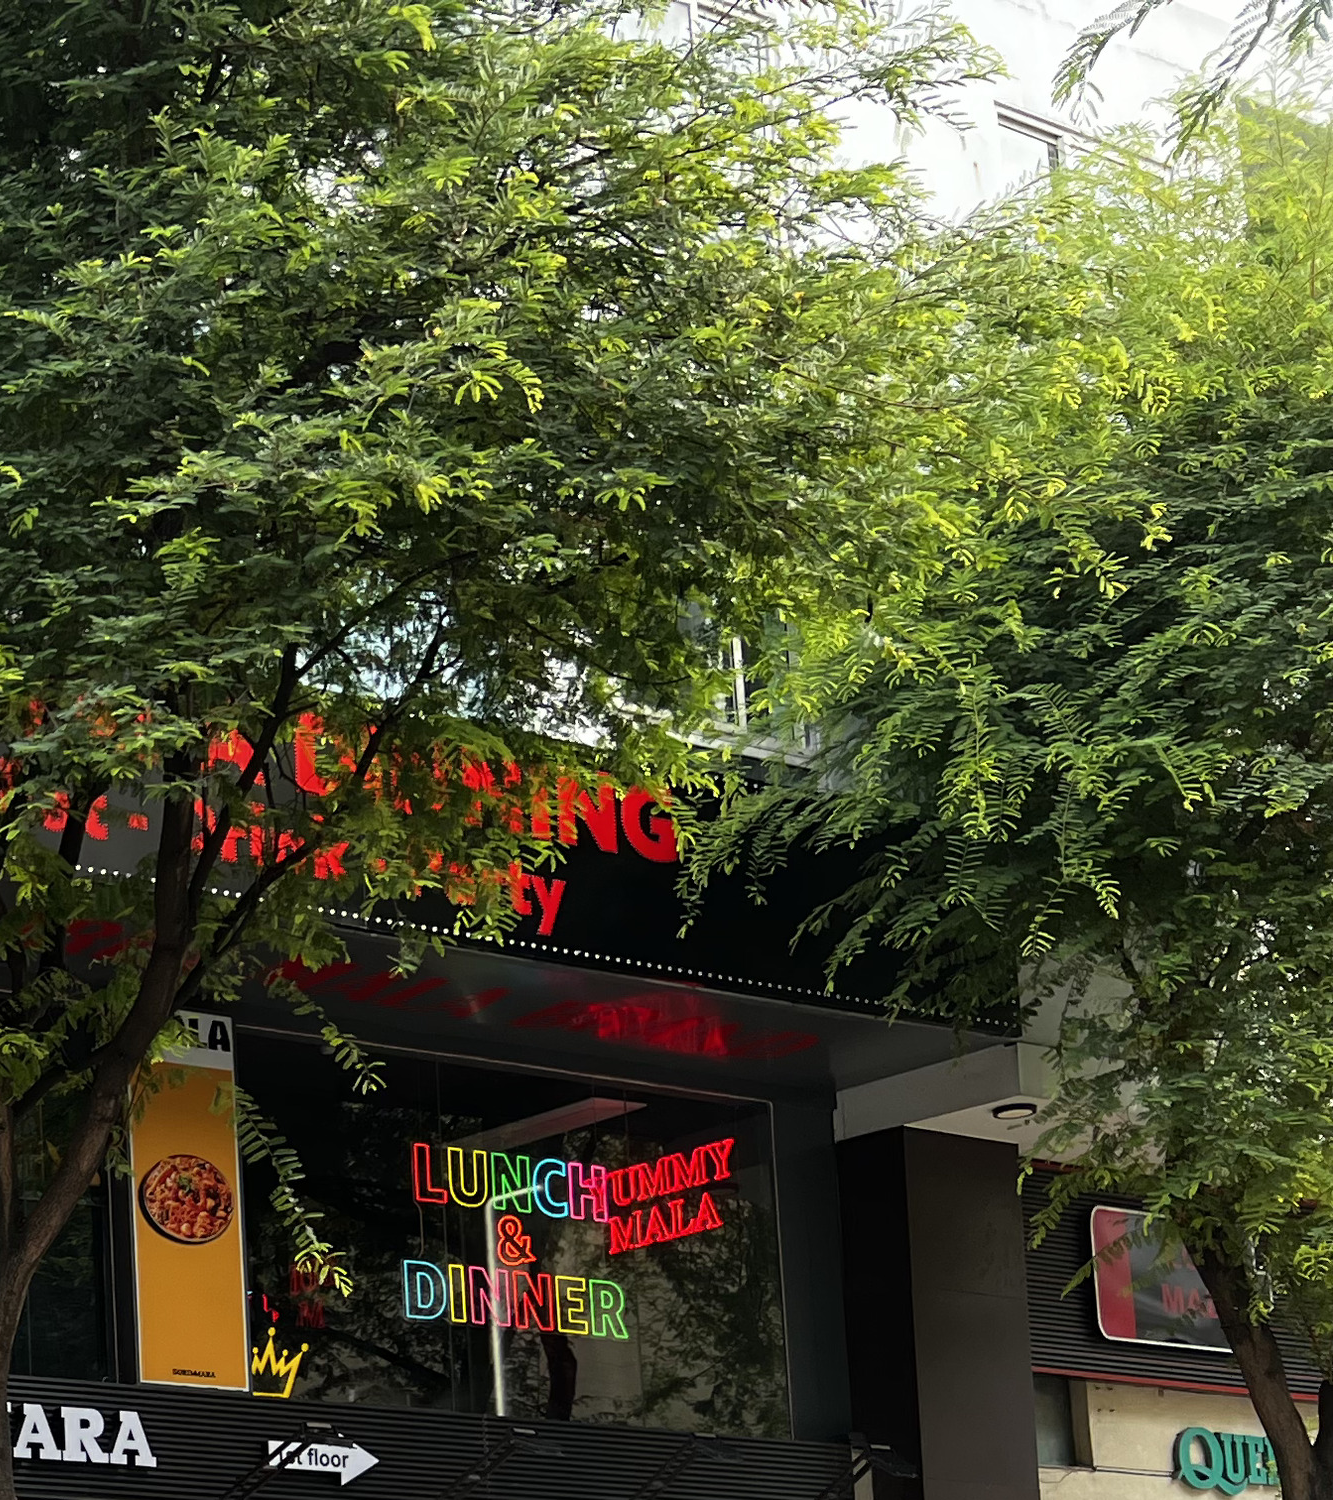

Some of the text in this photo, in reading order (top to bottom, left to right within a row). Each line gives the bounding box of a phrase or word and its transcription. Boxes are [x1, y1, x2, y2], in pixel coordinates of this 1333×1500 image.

[412, 1143, 608, 1223] LUNCH
[498, 1215, 537, 1267] &
[608, 1192, 724, 1255] MALA
[402, 1259, 629, 1340] DINNER
[307, 1448, 349, 1469] floor
